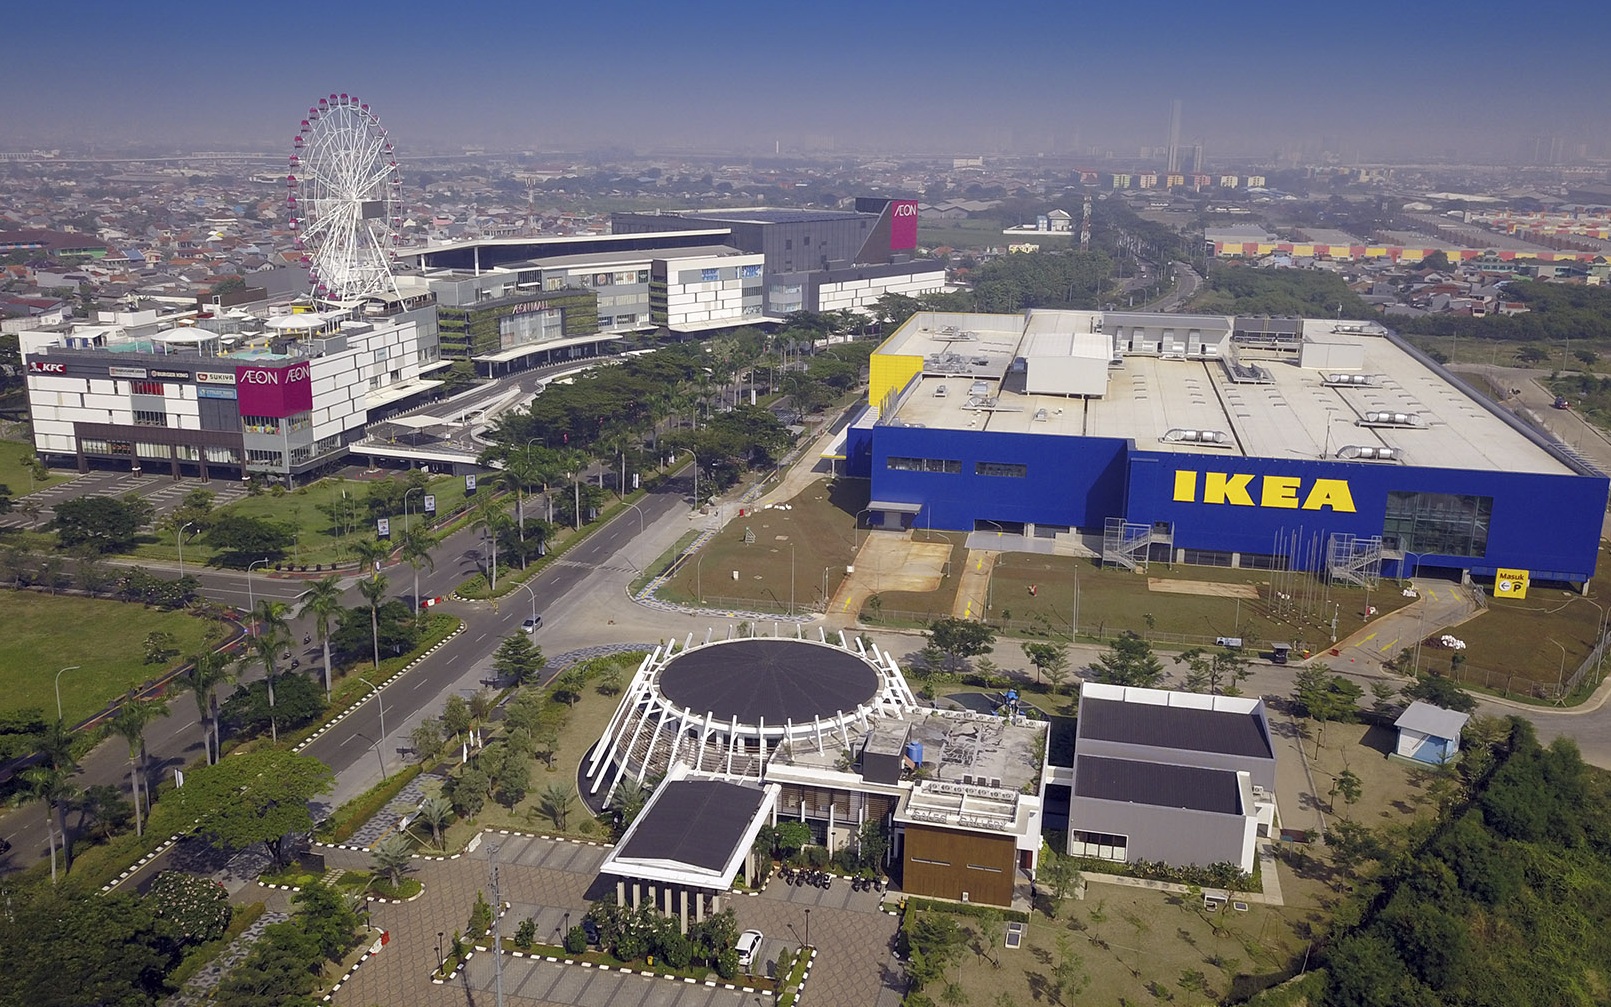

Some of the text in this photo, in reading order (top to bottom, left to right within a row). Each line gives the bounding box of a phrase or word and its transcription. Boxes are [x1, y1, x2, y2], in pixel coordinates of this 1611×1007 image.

[42, 363, 64, 373] KFC
[209, 373, 234, 381] SUKIYA
[1173, 470, 1357, 513] IKEA
[1513, 584, 1522, 592] P
